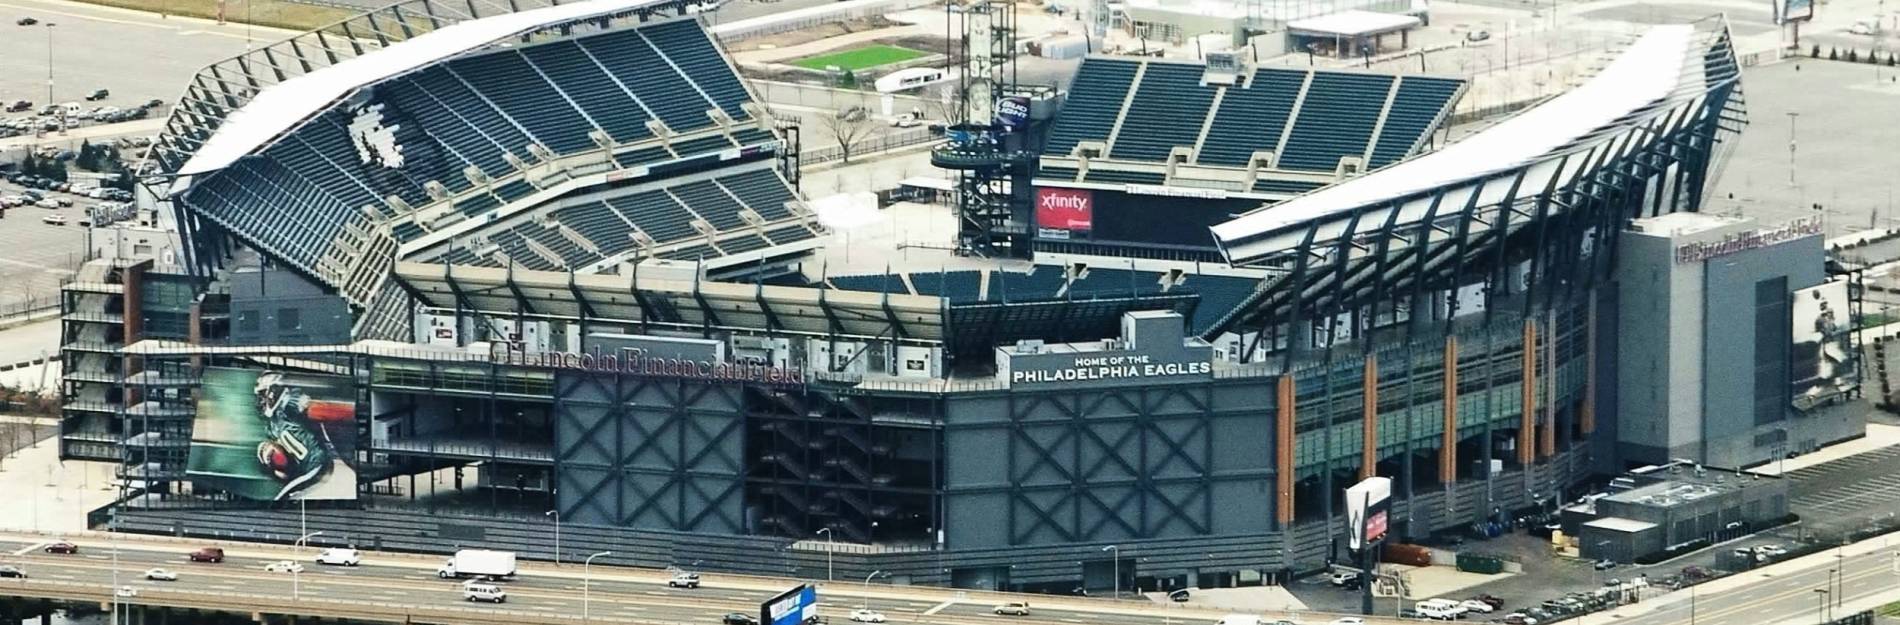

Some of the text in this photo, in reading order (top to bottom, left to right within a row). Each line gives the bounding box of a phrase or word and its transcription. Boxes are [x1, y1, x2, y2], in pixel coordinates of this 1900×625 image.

[969, 60, 991, 78] 92
[1001, 101, 1028, 113] BUD
[1042, 193, 1087, 211] xfinity
[518, 340, 805, 384] Lincoln Financial Field
[1075, 355, 1149, 366] HOME OF THE
[1013, 362, 1210, 383] PHILADELPHIA EAGLES
